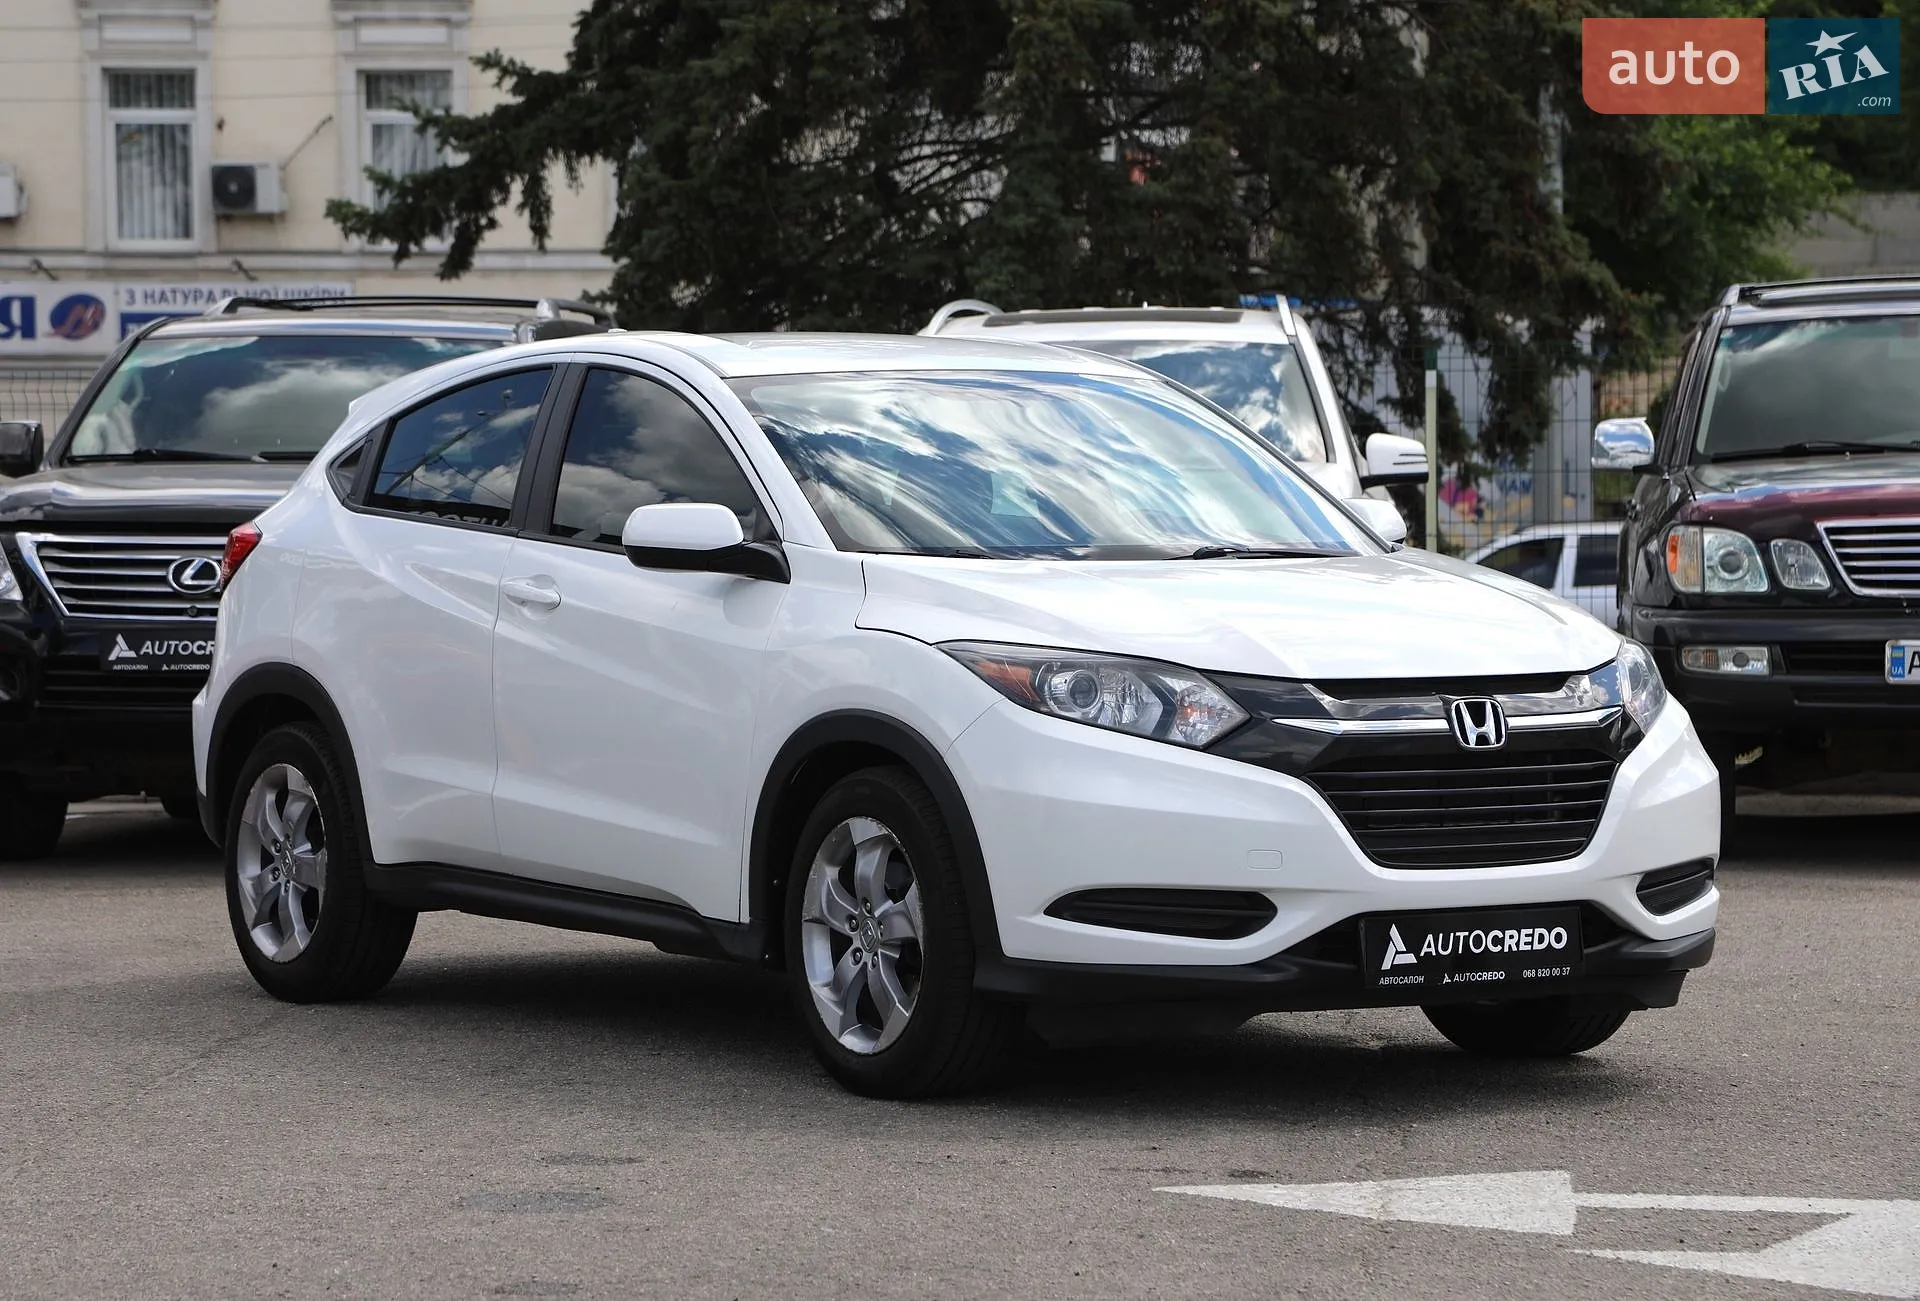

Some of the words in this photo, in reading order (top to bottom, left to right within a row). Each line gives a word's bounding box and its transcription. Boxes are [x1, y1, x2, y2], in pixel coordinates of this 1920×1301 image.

[1419, 926, 1568, 957] AUTOCREDO
[1453, 971, 1506, 983] AUTOCREDO
[1522, 969, 1536, 978] 068
[1537, 968, 1551, 977] 820
[1551, 967, 1561, 976] 00
[1562, 967, 1571, 975] 37
[1379, 975, 1425, 985] АВТОСАЛОН
